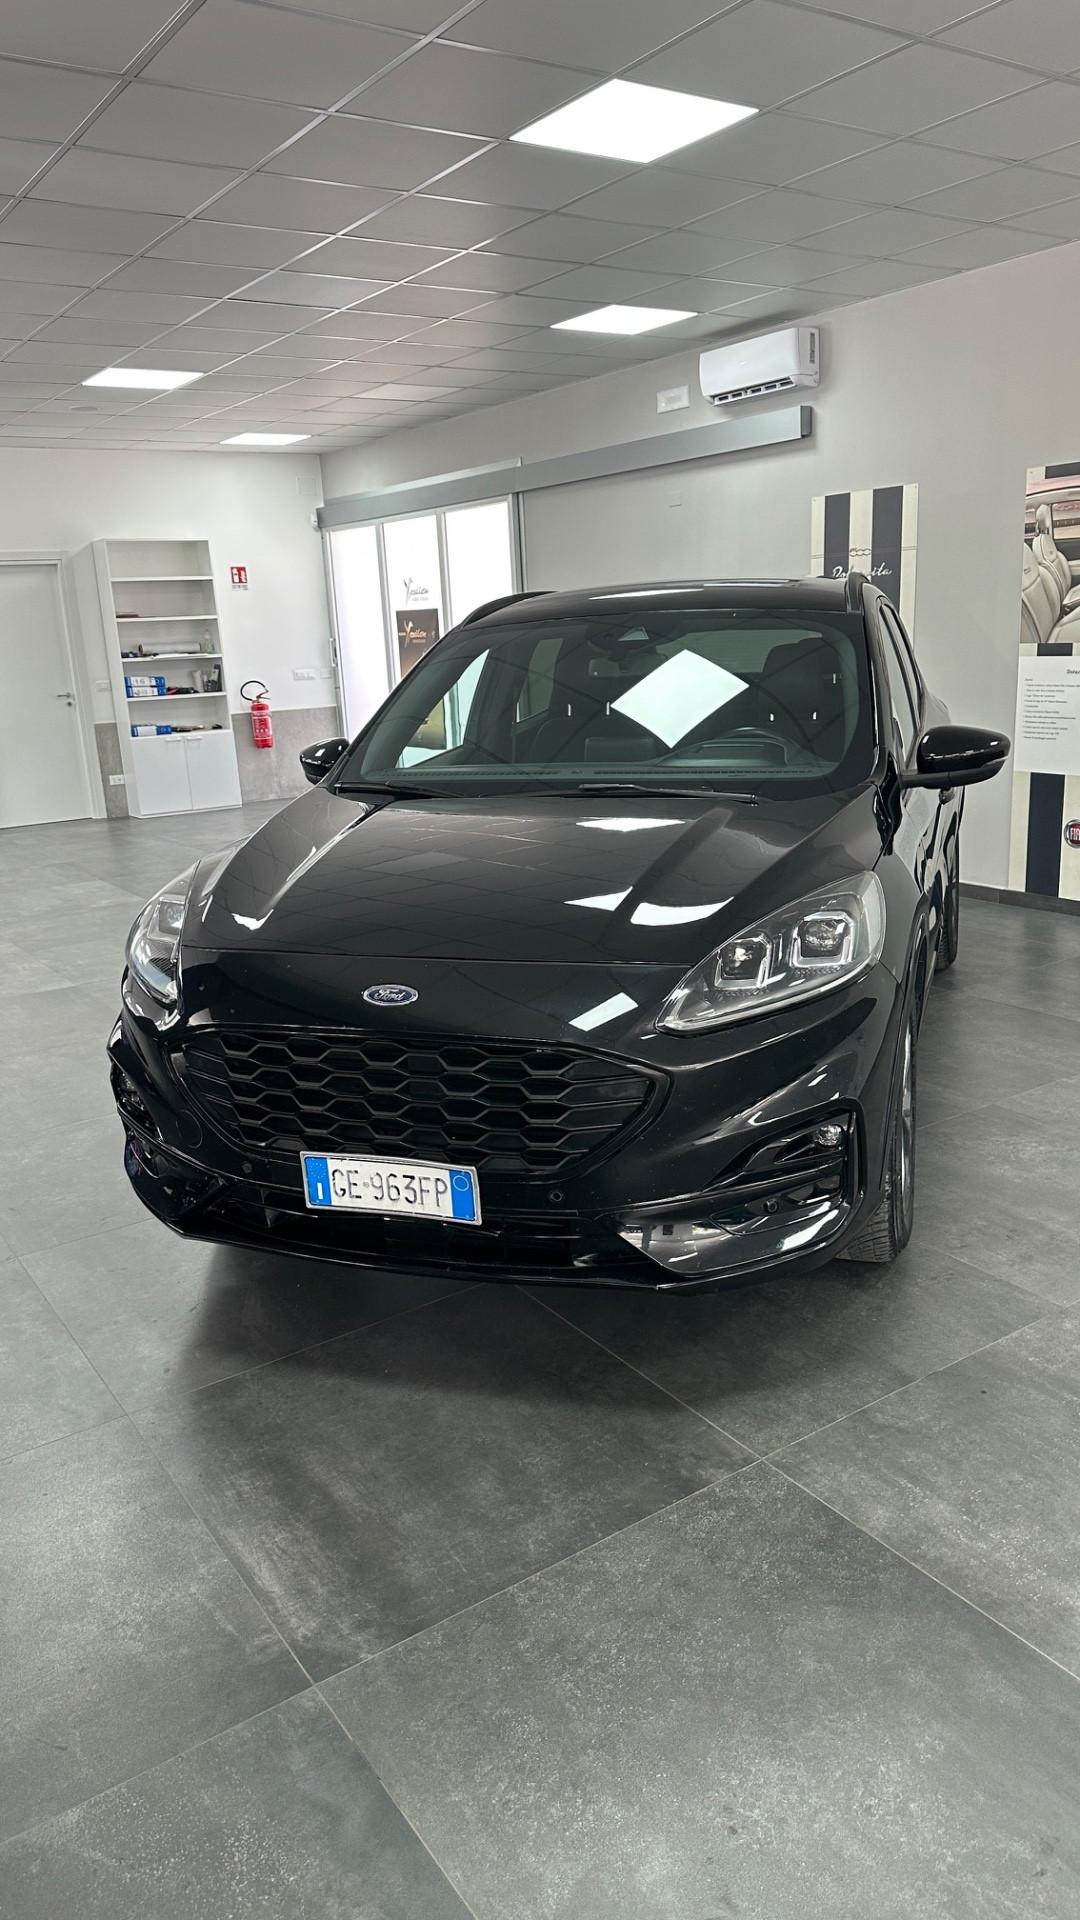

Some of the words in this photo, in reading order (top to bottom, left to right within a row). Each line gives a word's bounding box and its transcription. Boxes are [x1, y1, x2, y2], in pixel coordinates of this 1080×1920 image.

[373, 988, 406, 1001] Ford
[331, 1168, 362, 1199] GE
[370, 1171, 448, 1207] 963FP
